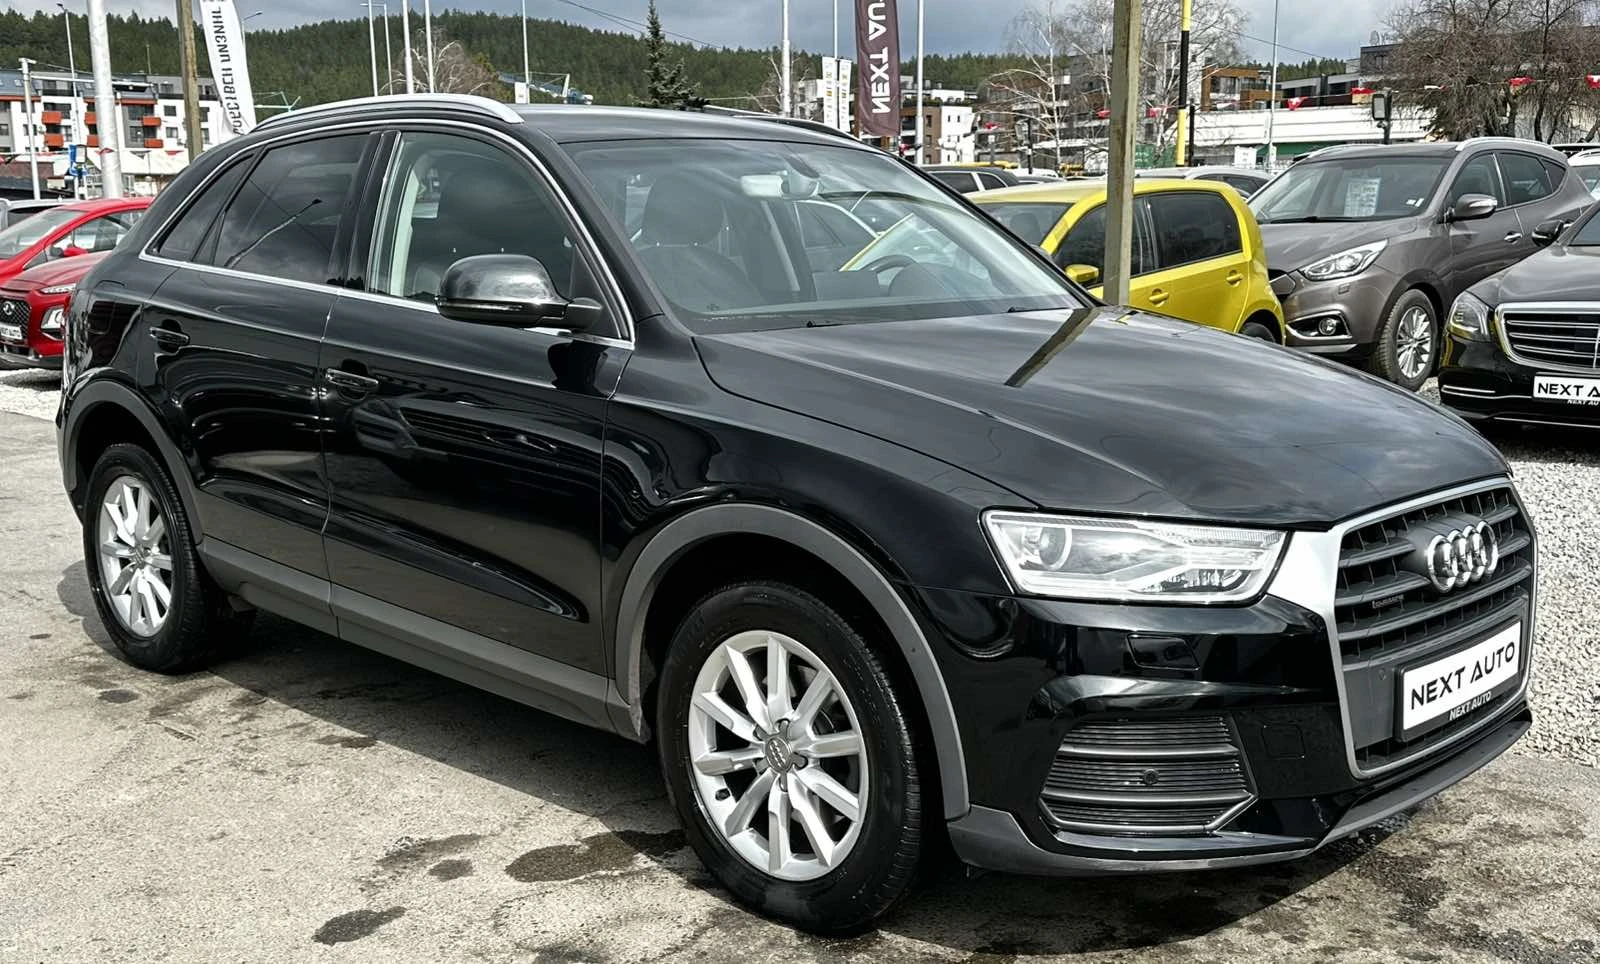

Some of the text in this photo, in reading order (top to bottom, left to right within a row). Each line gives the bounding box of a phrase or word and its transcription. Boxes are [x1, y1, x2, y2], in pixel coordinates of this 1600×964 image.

[1537, 383, 1584, 396] NEXT
[1410, 641, 1515, 710] NEXT AUTO
[1449, 691, 1491, 721] NEXT AUTO
